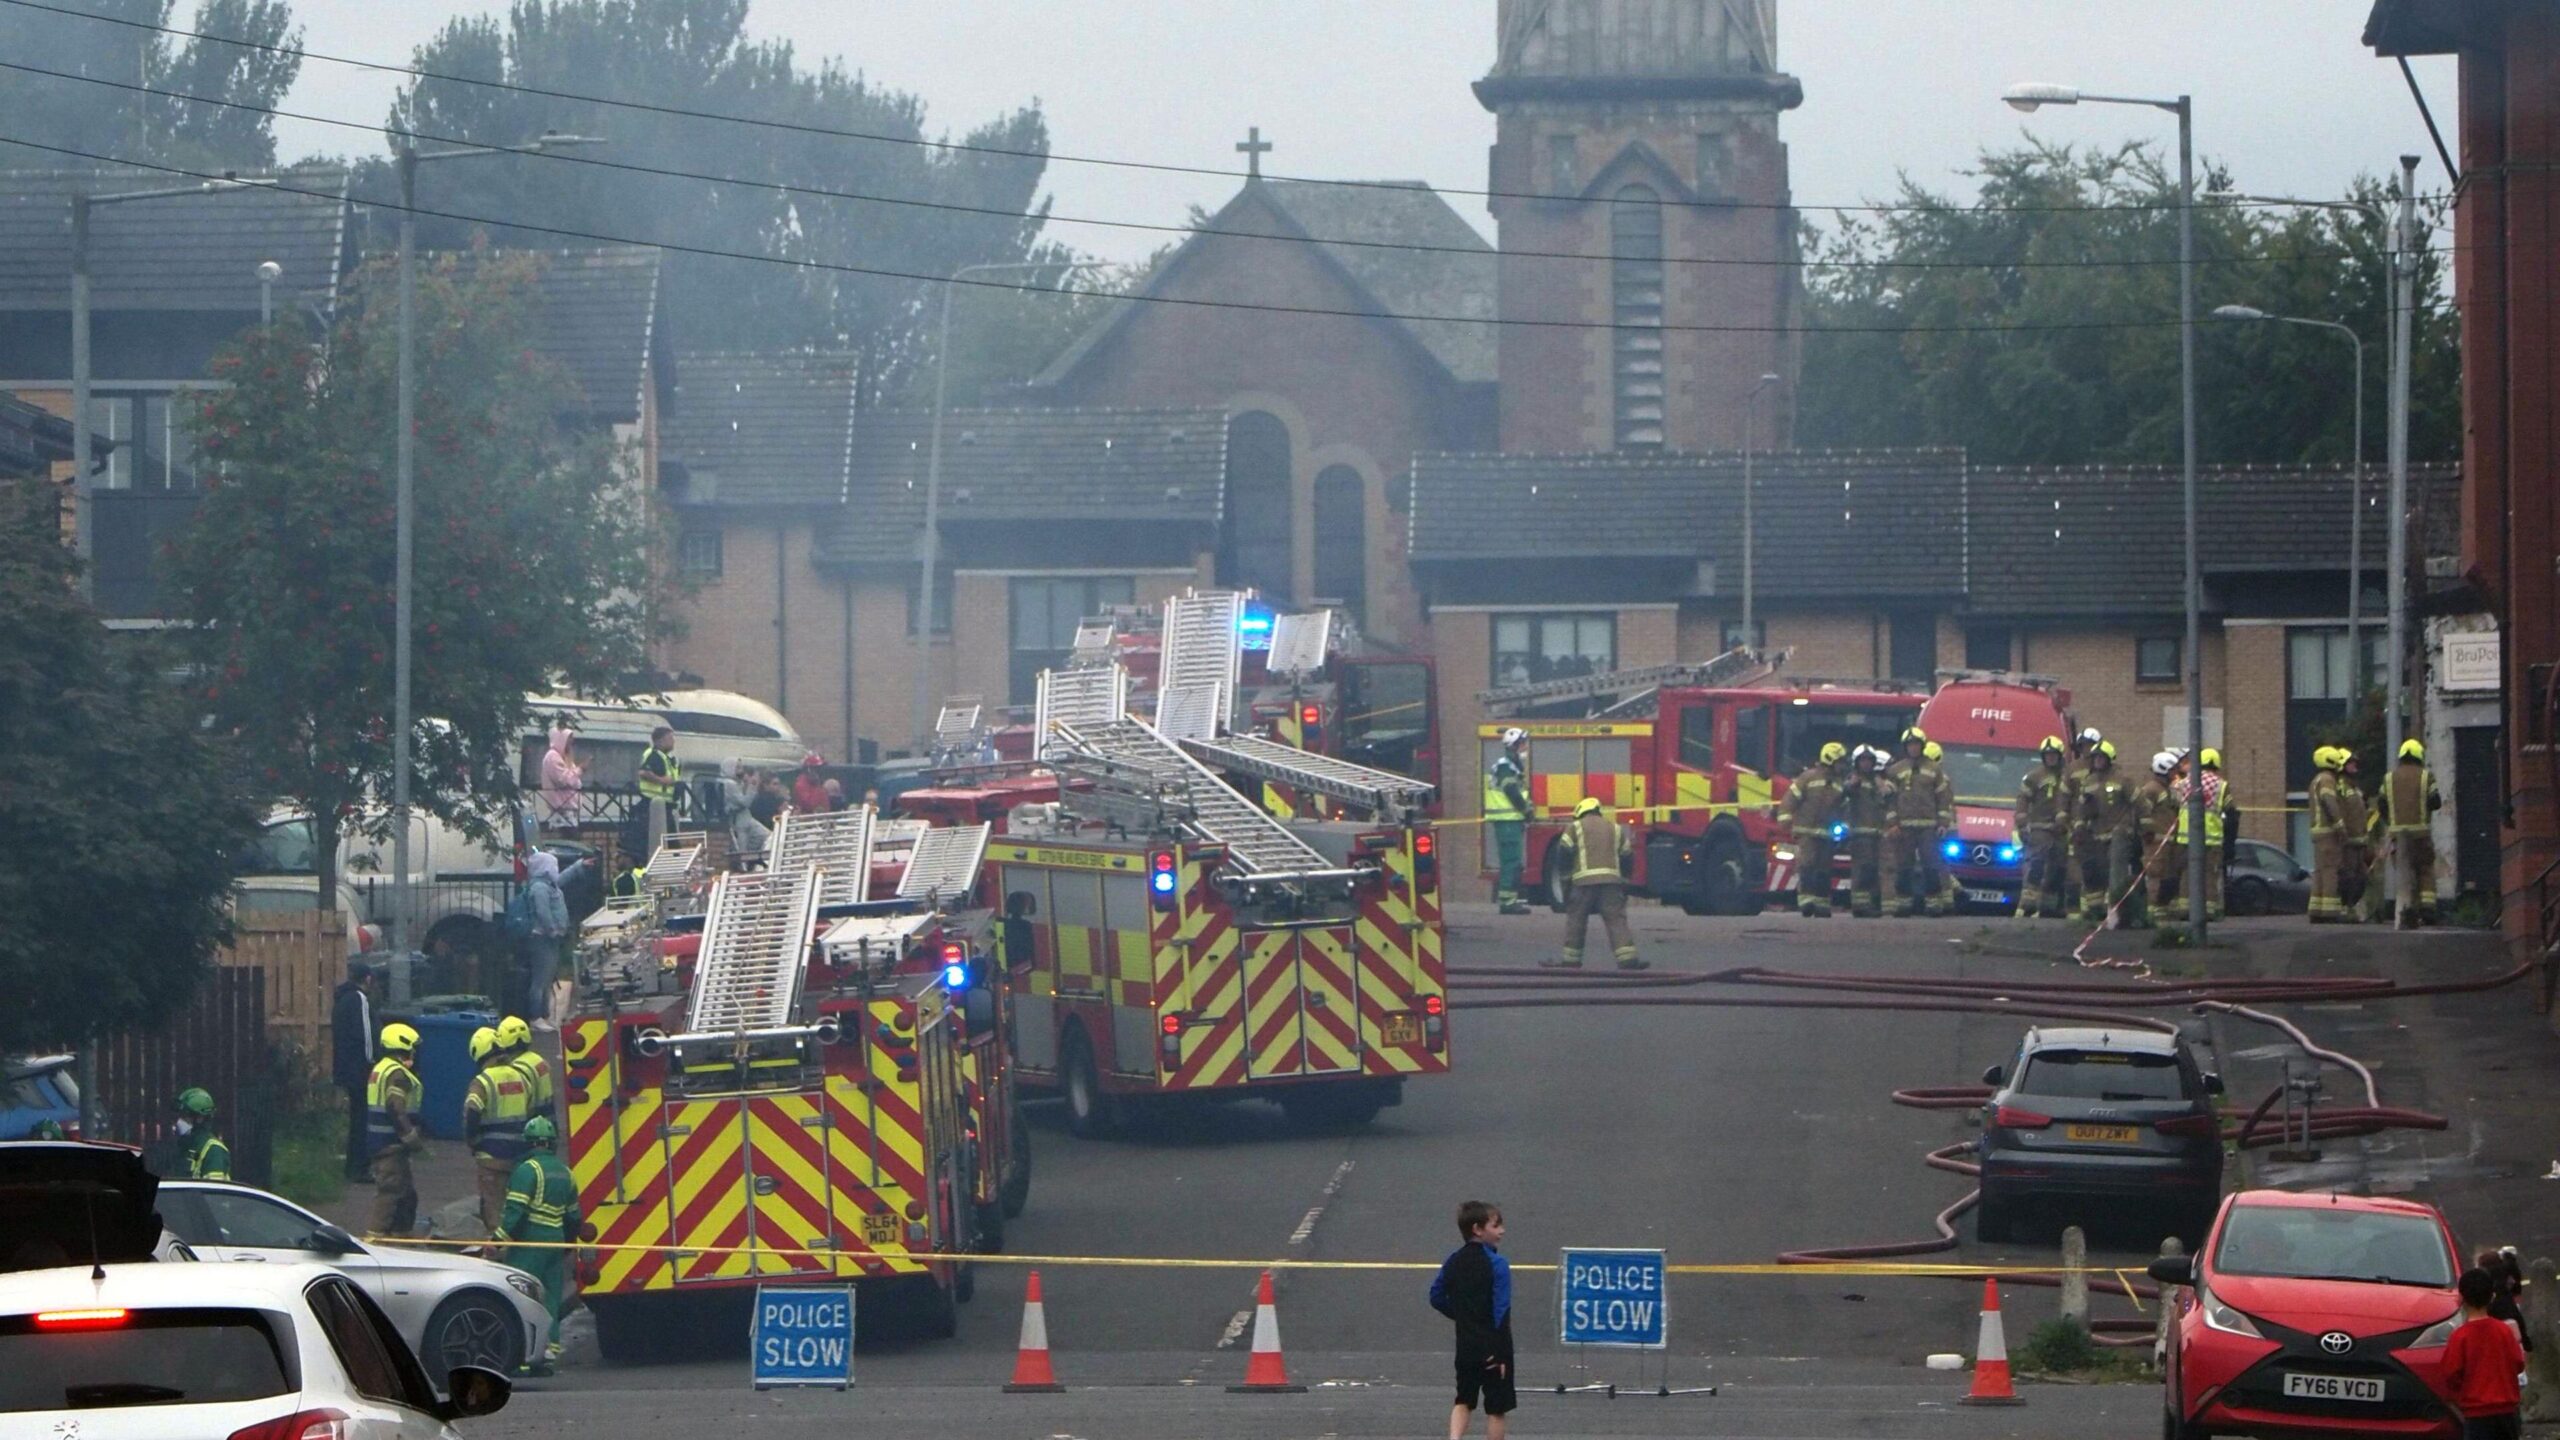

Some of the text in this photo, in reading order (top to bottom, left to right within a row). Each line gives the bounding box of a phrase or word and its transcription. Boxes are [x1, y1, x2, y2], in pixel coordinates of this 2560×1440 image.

[1971, 707, 2013, 721] FIRE
[863, 1216, 898, 1229] SL64
[1572, 1265, 1655, 1291] POLICE
[764, 1304, 846, 1328] POLICE
[1573, 1300, 1654, 1331] SLOW
[764, 1337, 845, 1368] SLOW
[2291, 1376, 2378, 1398] FY66 VCD
